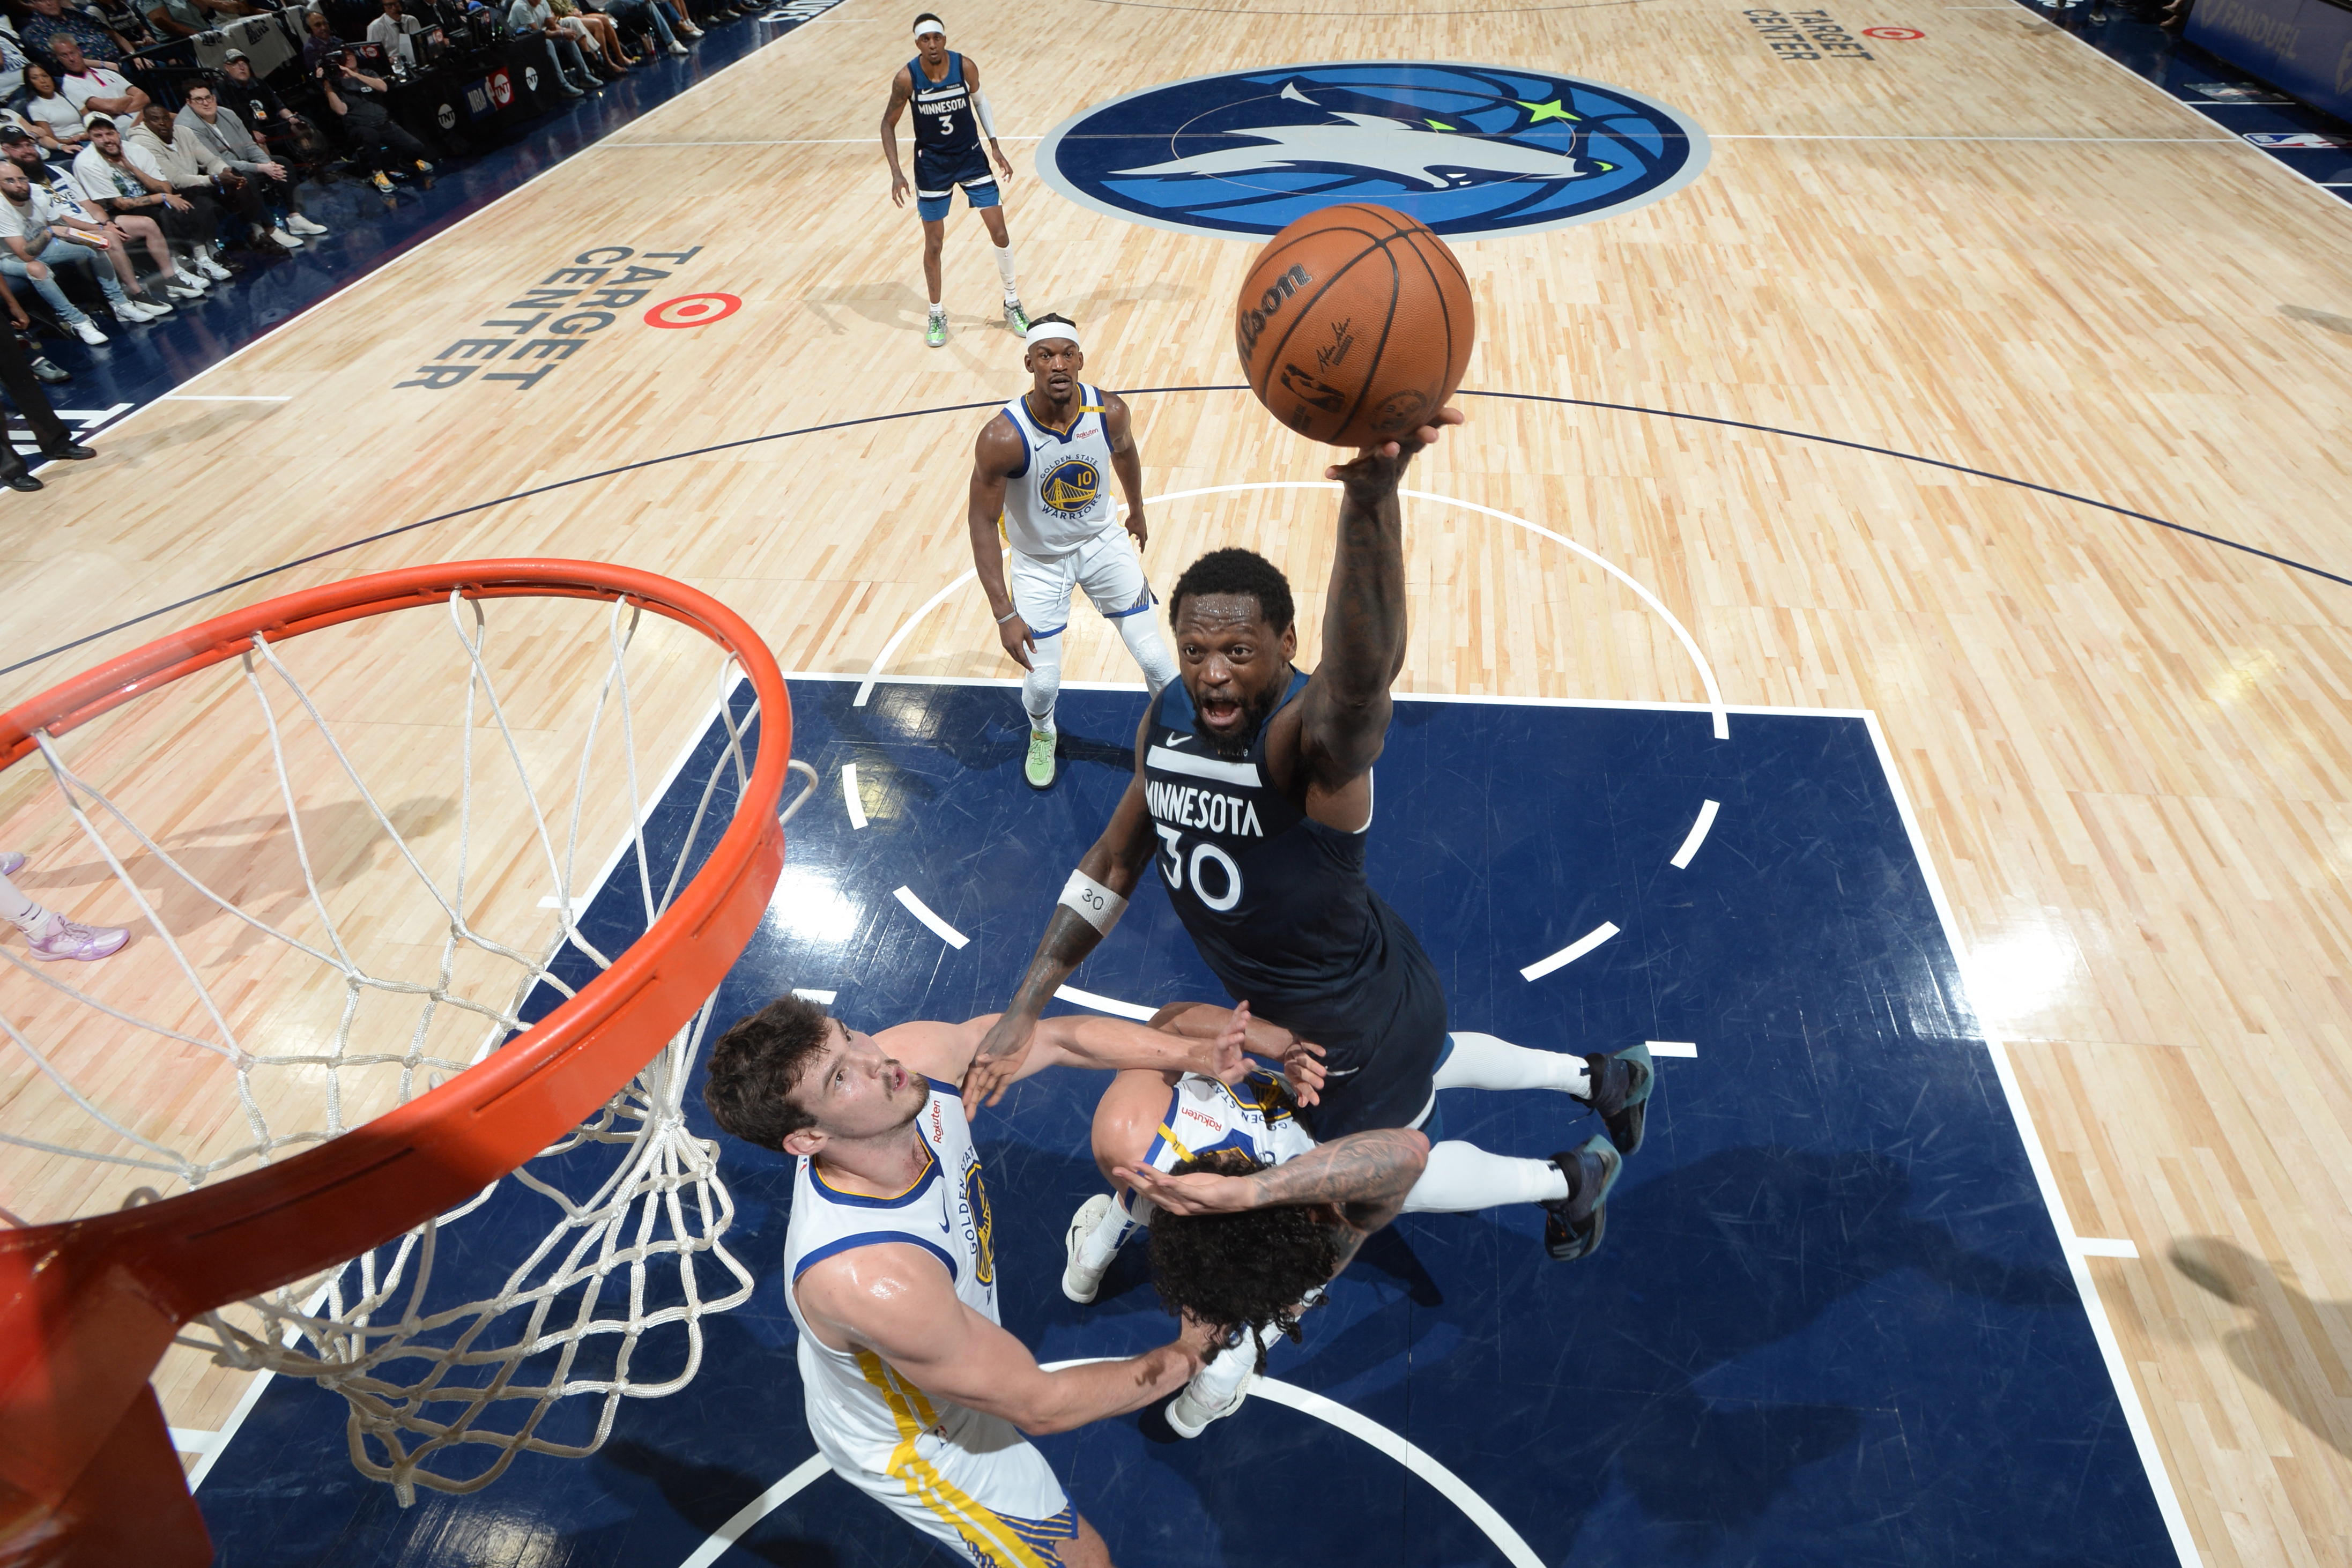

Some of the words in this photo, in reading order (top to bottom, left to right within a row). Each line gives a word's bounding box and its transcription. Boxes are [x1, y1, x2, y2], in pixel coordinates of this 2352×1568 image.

[1743, 9, 1821, 60] CENTER
[1789, 10, 1875, 61] TARGET
[468, 87, 487, 114] NBA
[495, 81, 510, 98] TNT
[918, 98, 967, 115] MINNESOTA
[438, 110, 455, 124] TNT
[939, 115, 954, 136] 3
[392, 247, 635, 389] CENTER
[480, 246, 704, 390] TARGET
[1076, 428, 1099, 439] Rakuten
[1041, 455, 1071, 479] GOLDEN
[1075, 454, 1098, 466] STATE
[1078, 471, 1092, 486] 10
[1042, 493, 1102, 519] WARRIORS
[1146, 779, 1263, 837] MINNESOTA
[1155, 822, 1243, 911] 30
[1082, 888, 1104, 911] 30
[933, 1100, 941, 1144] Rakuten
[1181, 1106, 1222, 1132] Rakuten
[959, 1178, 977, 1255] GOLDEN
